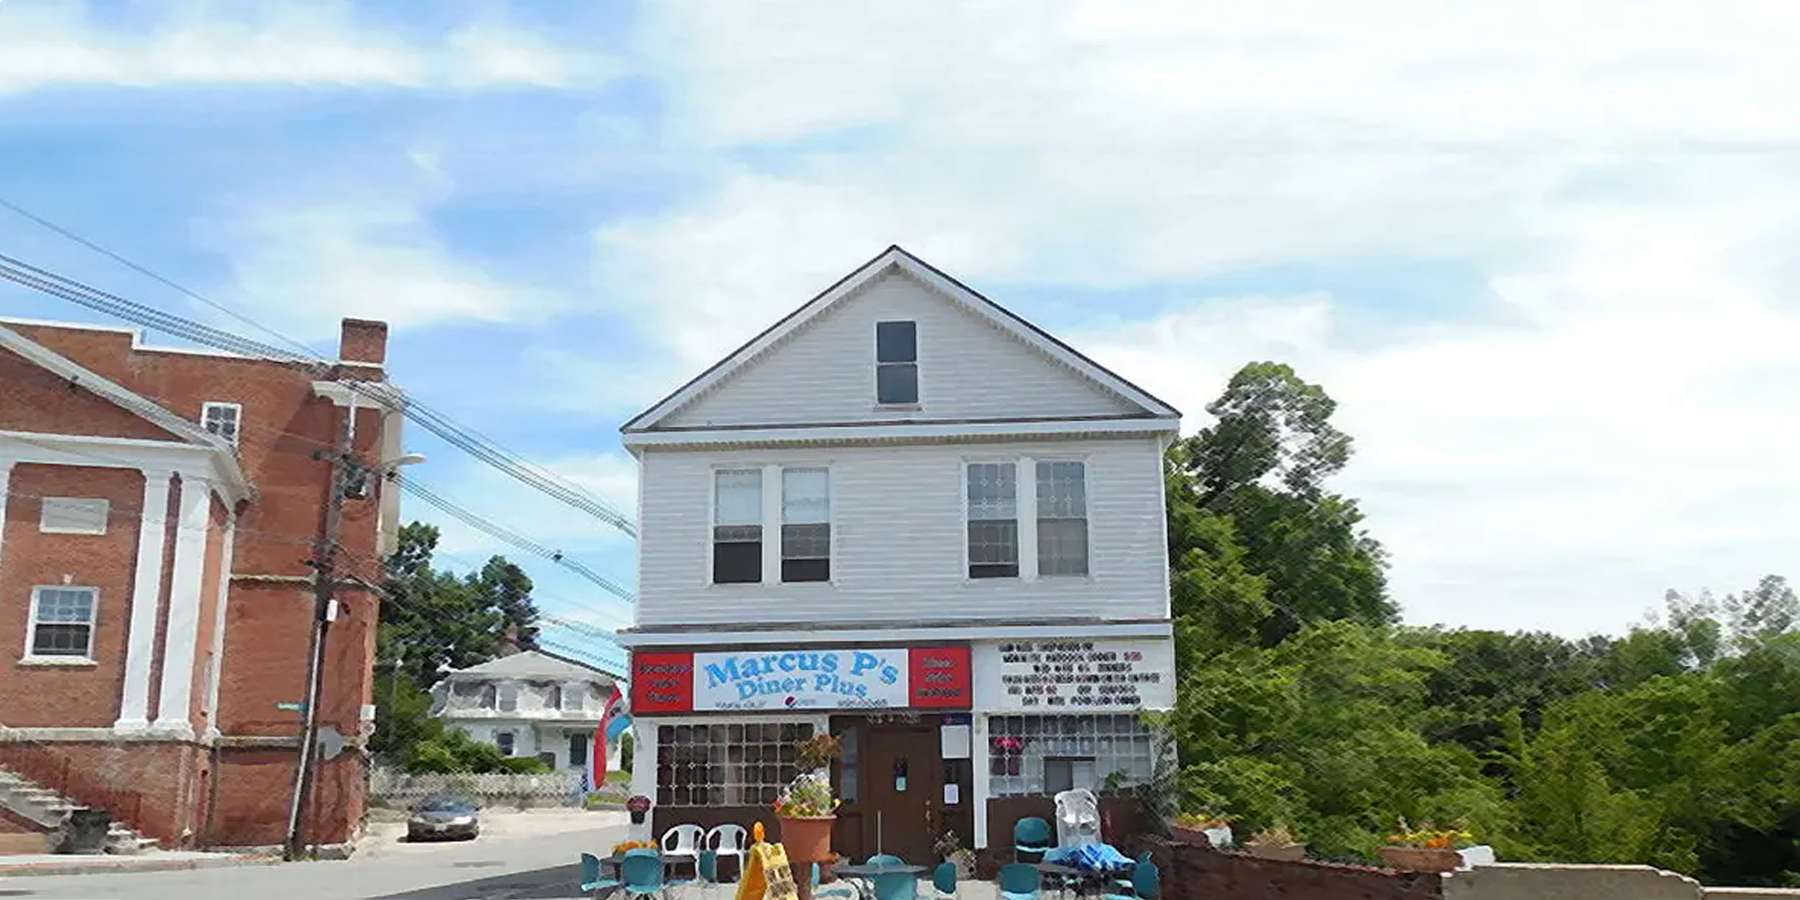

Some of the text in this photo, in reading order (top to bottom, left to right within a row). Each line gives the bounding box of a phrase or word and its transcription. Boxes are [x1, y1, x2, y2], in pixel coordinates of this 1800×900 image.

[704, 651, 899, 688] Marcus P's
[736, 673, 867, 700] Diner Plus
